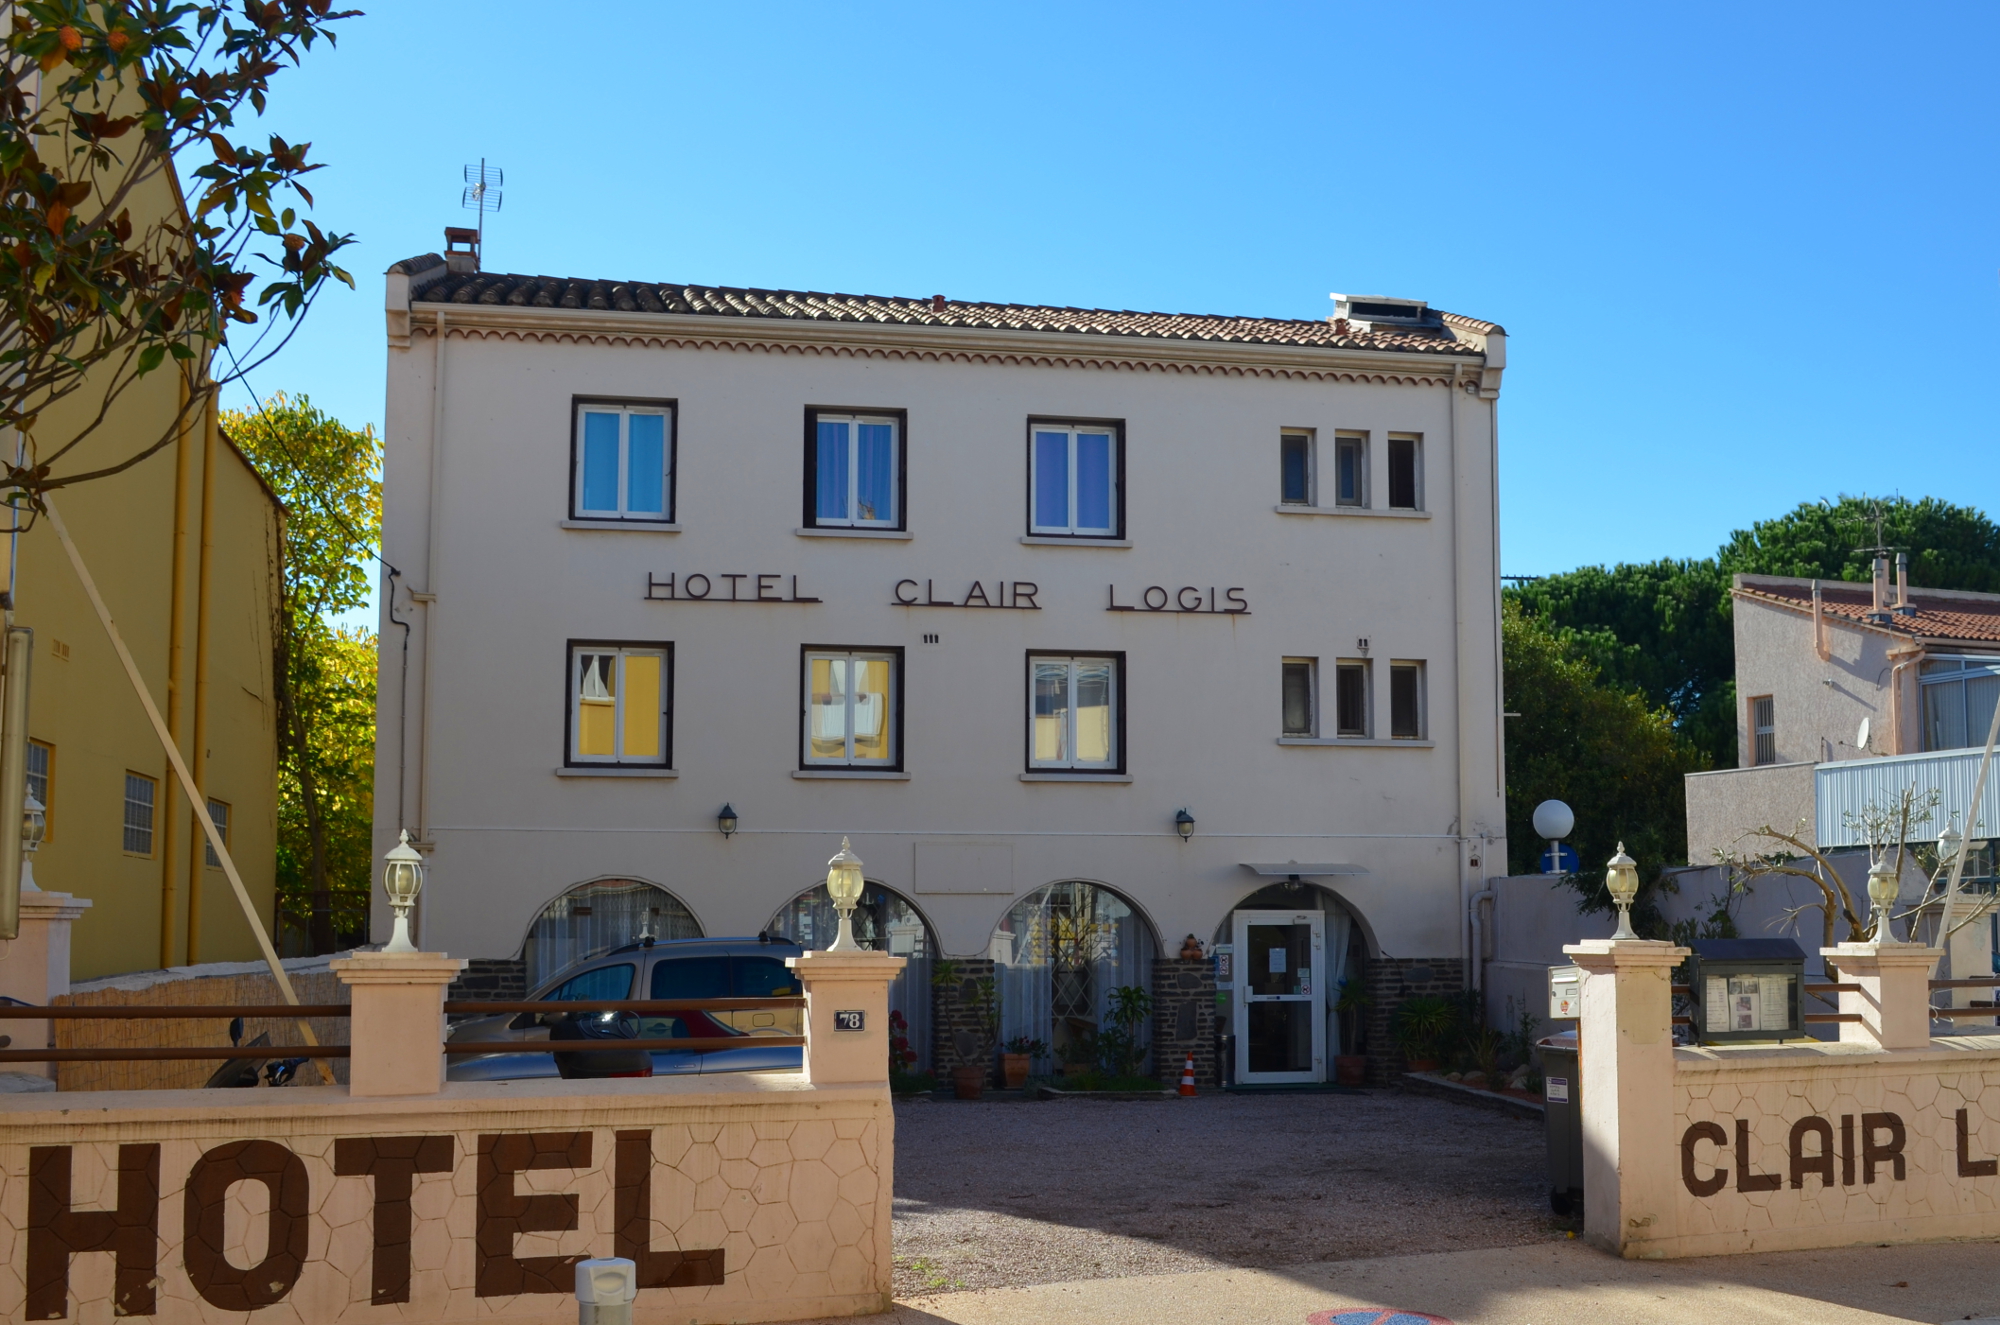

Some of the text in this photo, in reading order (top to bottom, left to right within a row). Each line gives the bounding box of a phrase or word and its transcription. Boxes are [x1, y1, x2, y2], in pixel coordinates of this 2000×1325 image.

[647, 571, 1248, 613] HOTEL CLAIR LOGIS
[839, 1013, 860, 1028] 78
[1680, 1108, 1998, 1198] CLAIR L
[25, 1128, 725, 1321] HOTEL
